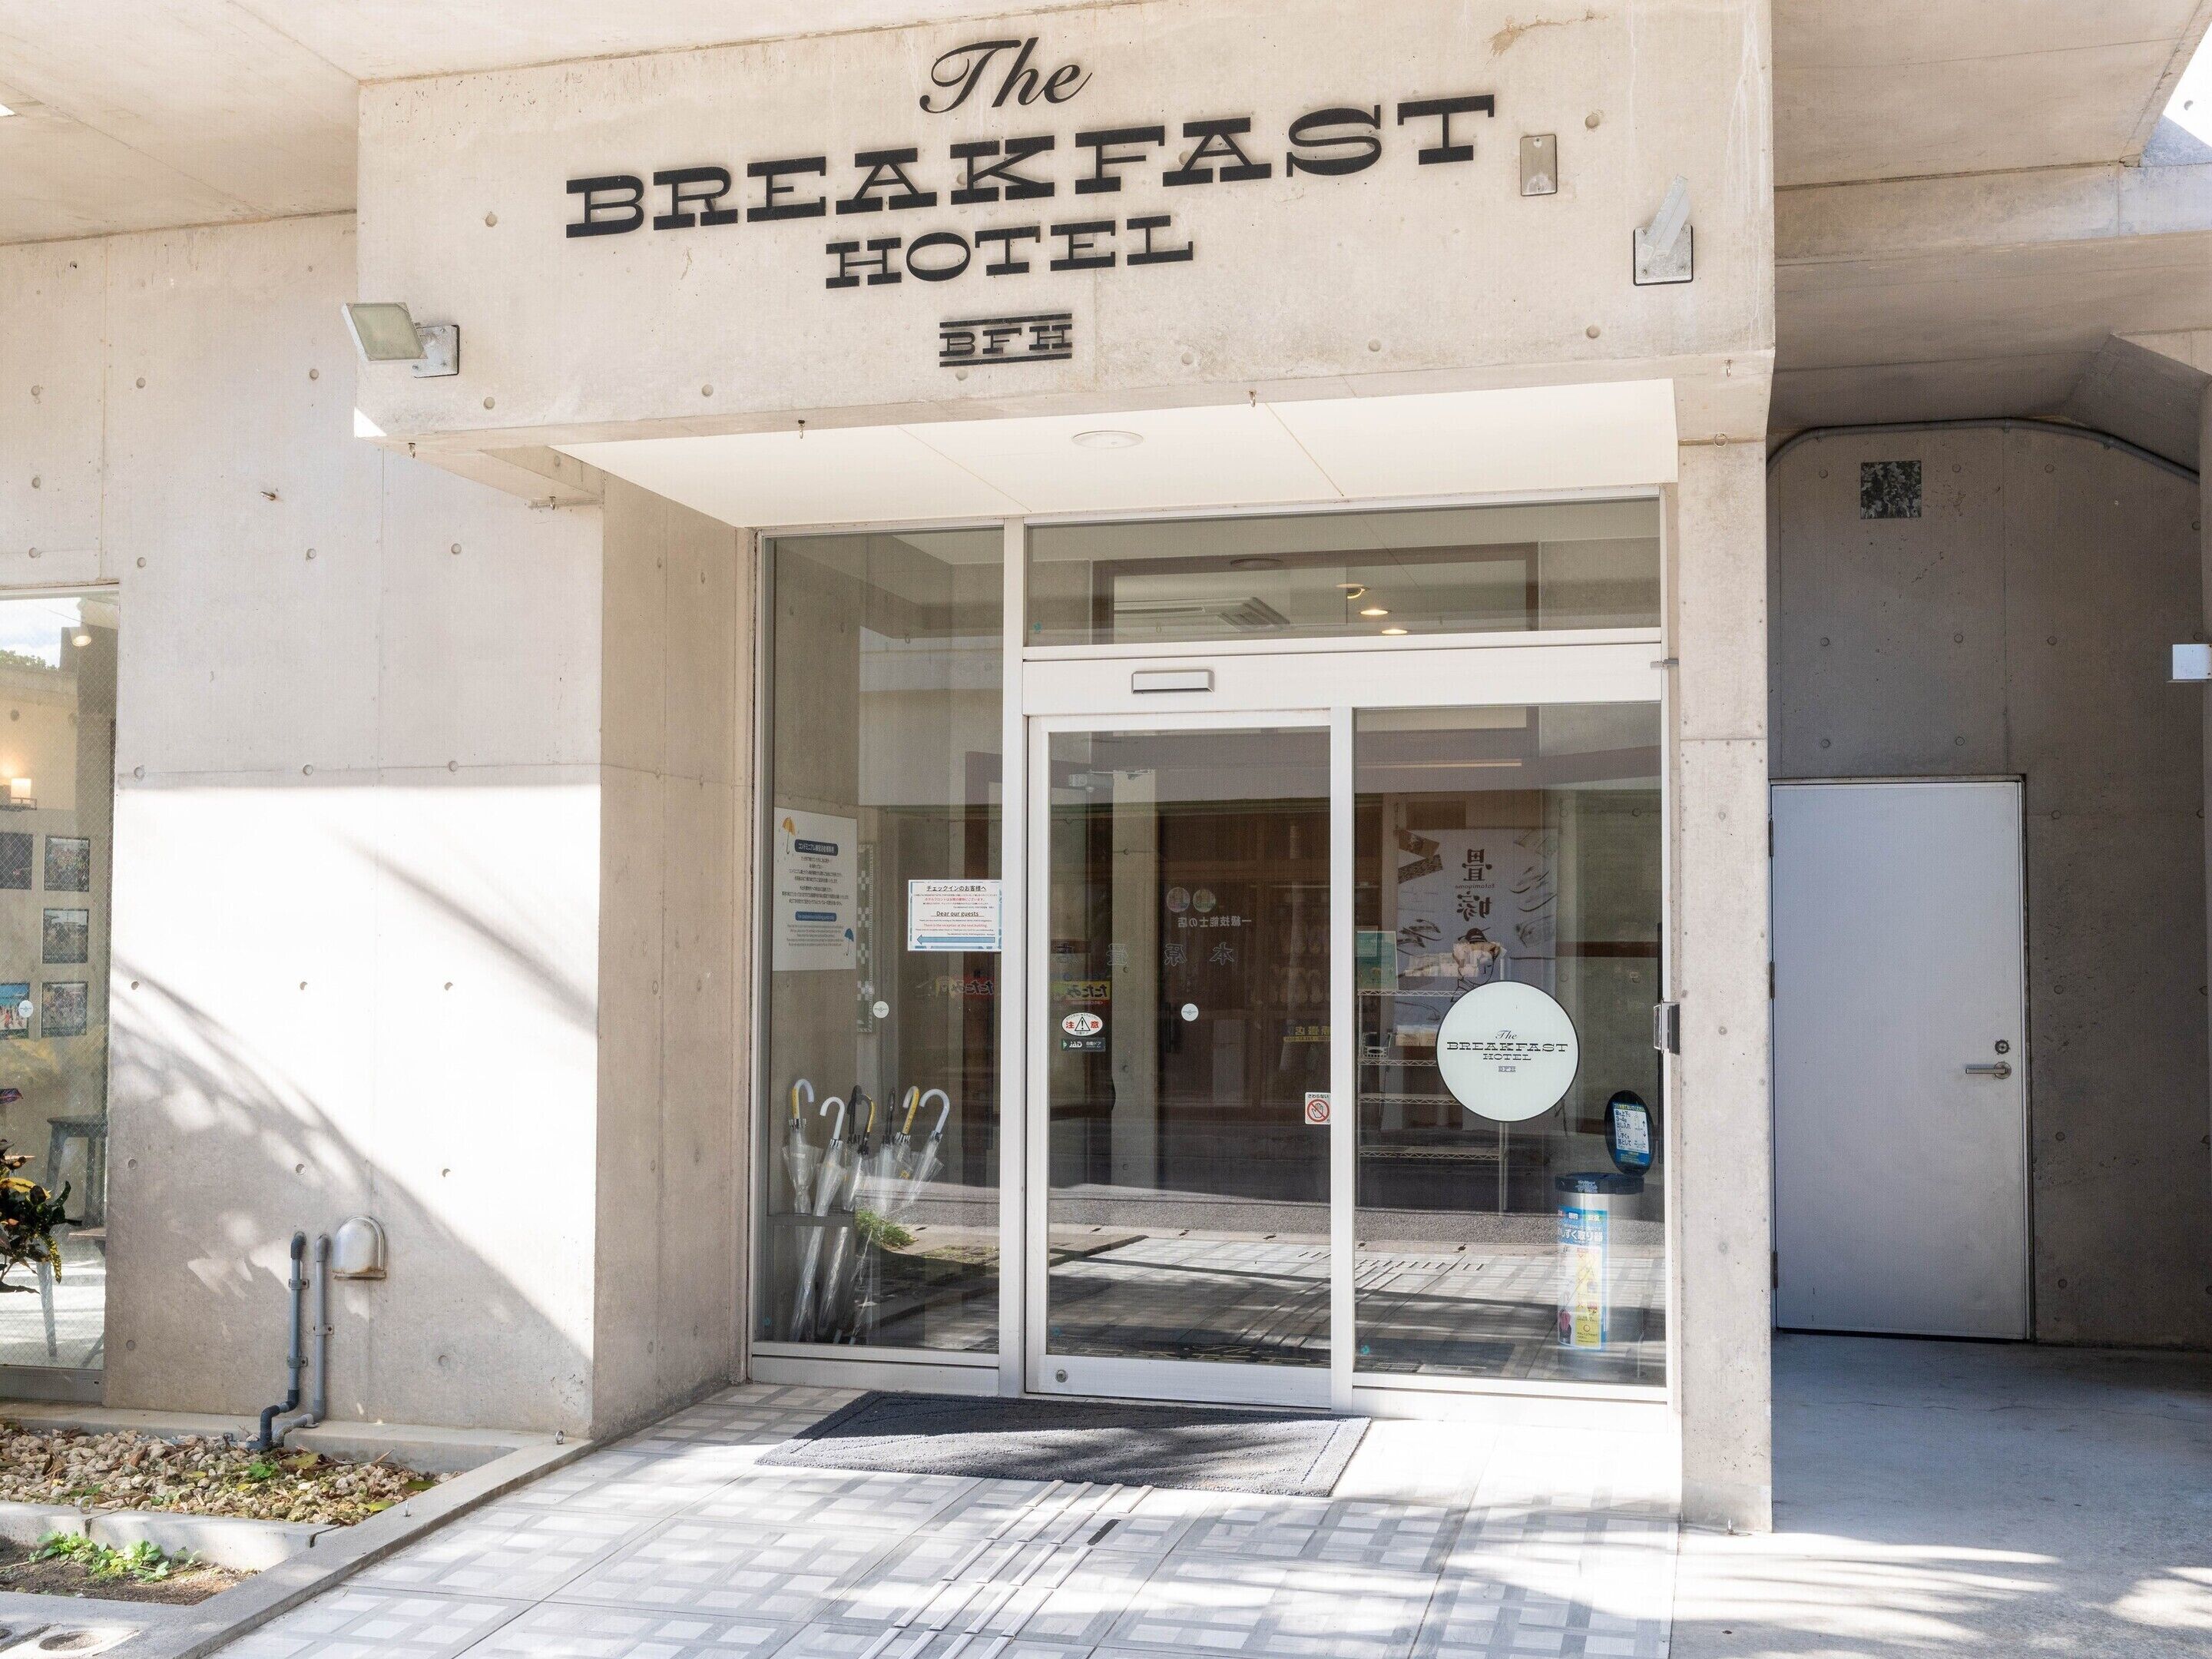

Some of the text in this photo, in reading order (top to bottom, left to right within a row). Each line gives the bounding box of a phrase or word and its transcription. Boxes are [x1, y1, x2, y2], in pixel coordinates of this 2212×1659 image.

[920, 37, 1093, 114] The
[566, 94, 1495, 239] BREAKFAST
[826, 215, 1194, 290] HOTEL
[939, 323, 1073, 358] BFH
[1446, 1041, 1568, 1052] BREAKFAST
[1495, 1030, 1518, 1040] The
